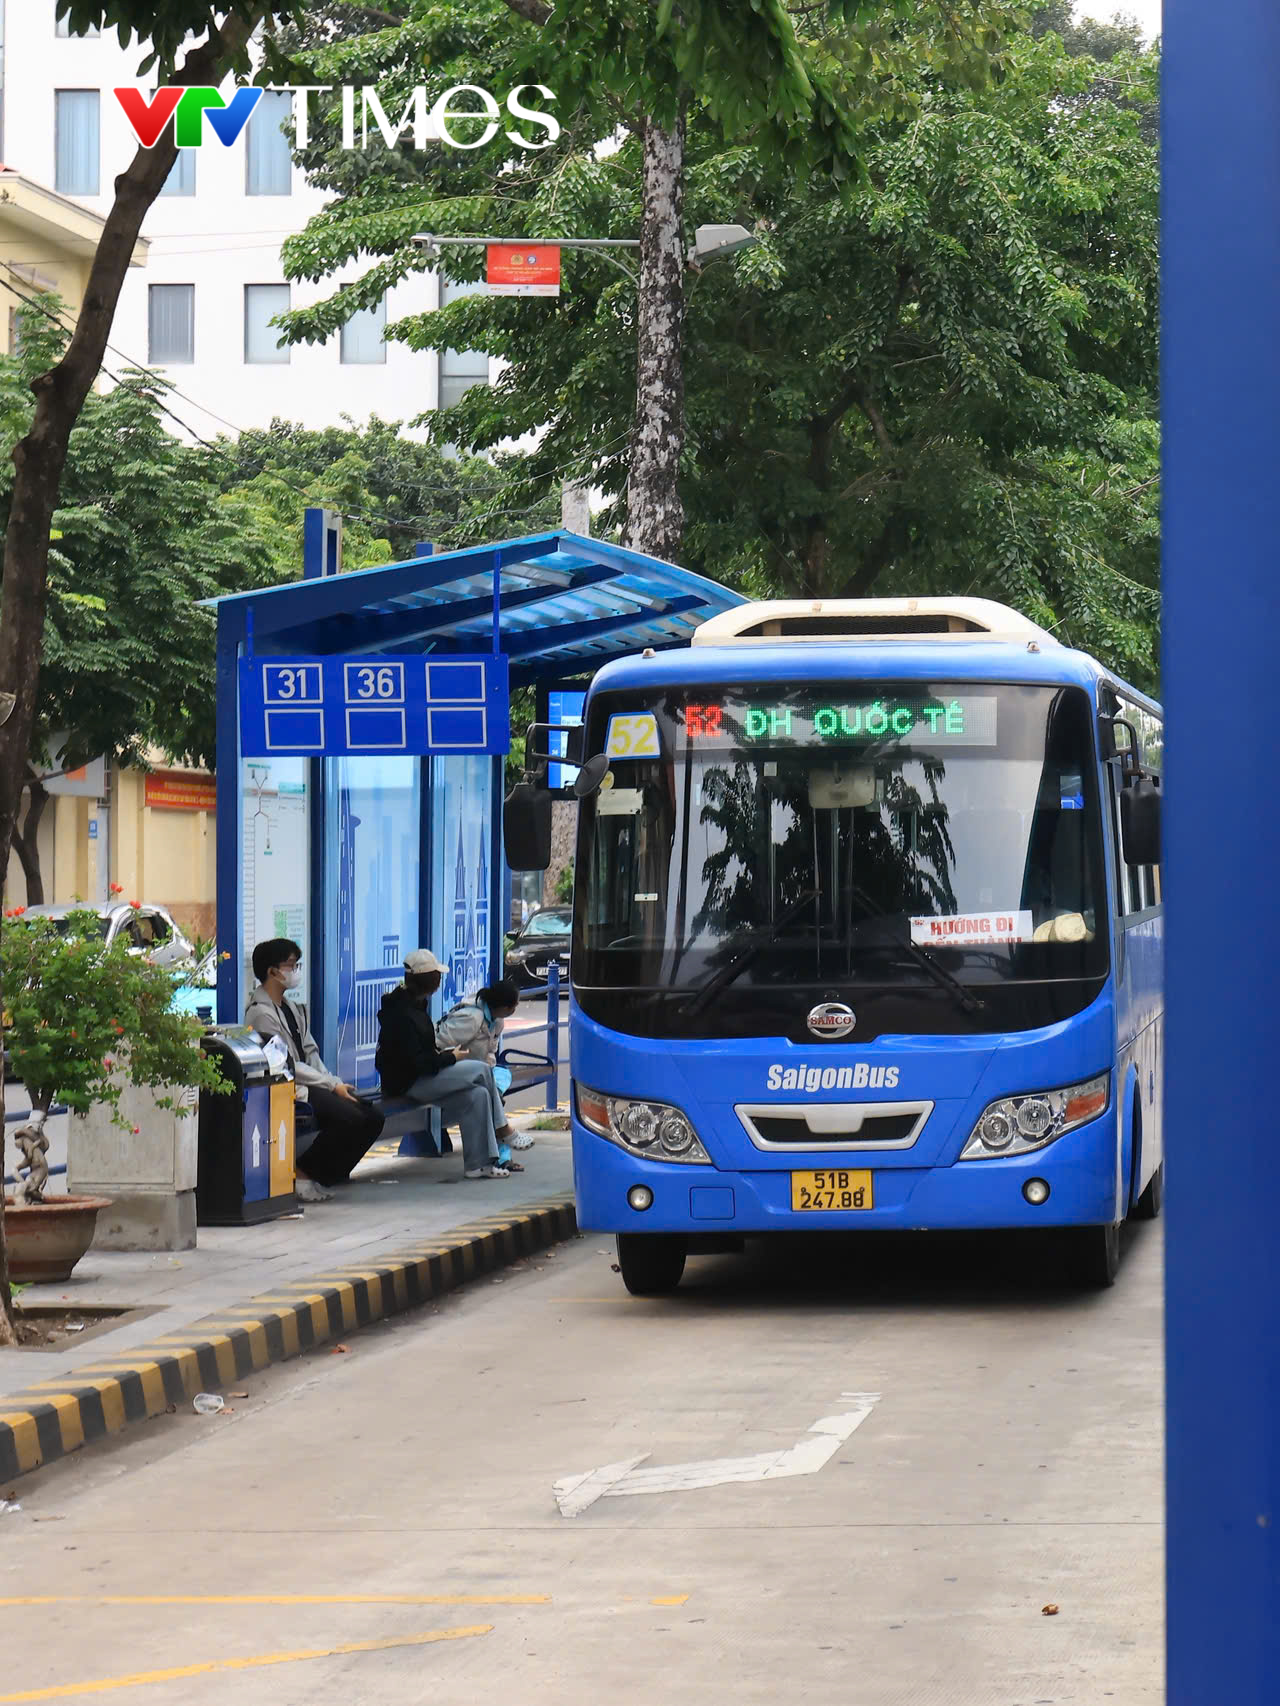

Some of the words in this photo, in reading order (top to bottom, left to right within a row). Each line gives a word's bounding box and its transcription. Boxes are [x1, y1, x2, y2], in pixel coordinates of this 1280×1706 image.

[278, 668, 307, 699] 31
[357, 667, 394, 699] 36
[685, 704, 723, 737] 52
[744, 710, 792, 736] ĐH
[612, 717, 655, 754] 52
[930, 917, 991, 936] HƯỚNG
[810, 1016, 852, 1025] SAMCO
[767, 1063, 900, 1093] SaigonBus
[814, 1172, 849, 1189] 51B
[801, 1191, 864, 1209] 247.88
